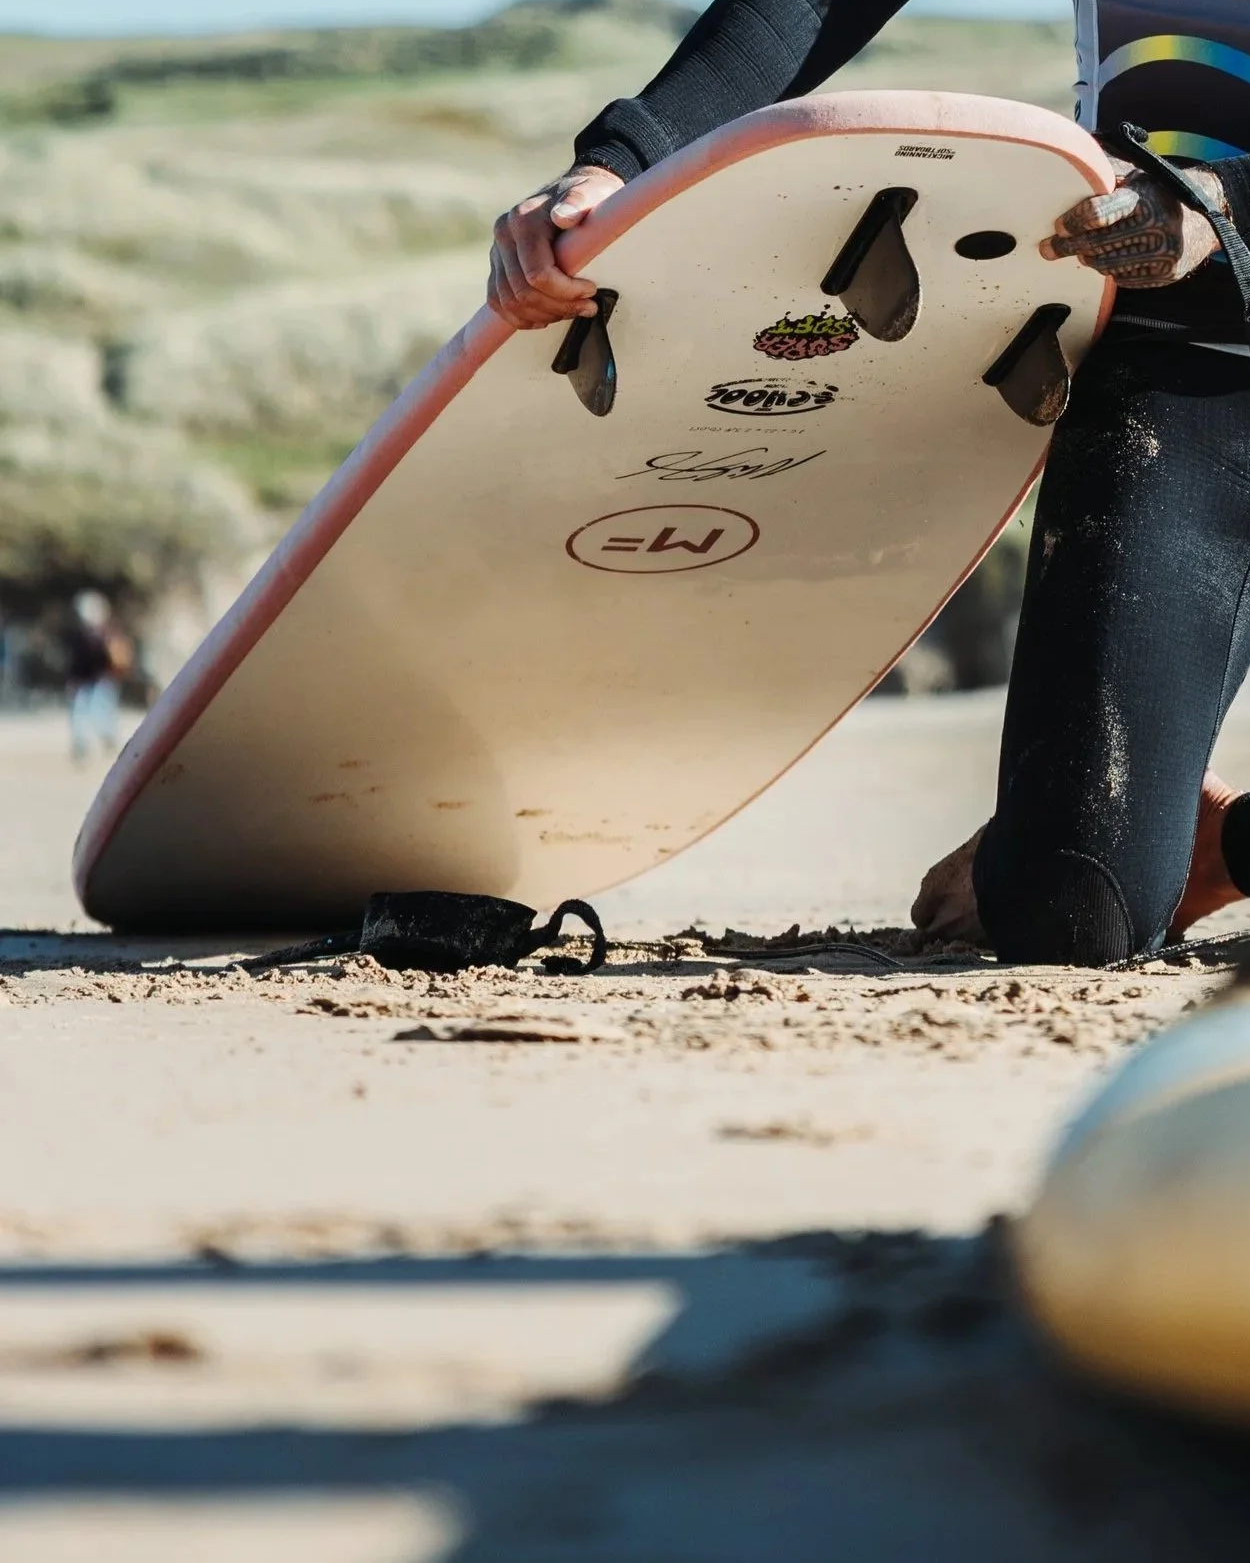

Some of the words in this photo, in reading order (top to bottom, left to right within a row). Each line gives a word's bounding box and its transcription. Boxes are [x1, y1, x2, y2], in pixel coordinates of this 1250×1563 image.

[894, 151, 954, 160] MICKFANNING
[898, 145, 953, 154] SOFTBOARDS
[768, 314, 850, 336] SOFT
[753, 333, 857, 361] SUPER
[704, 389, 836, 408] SCHOOL
